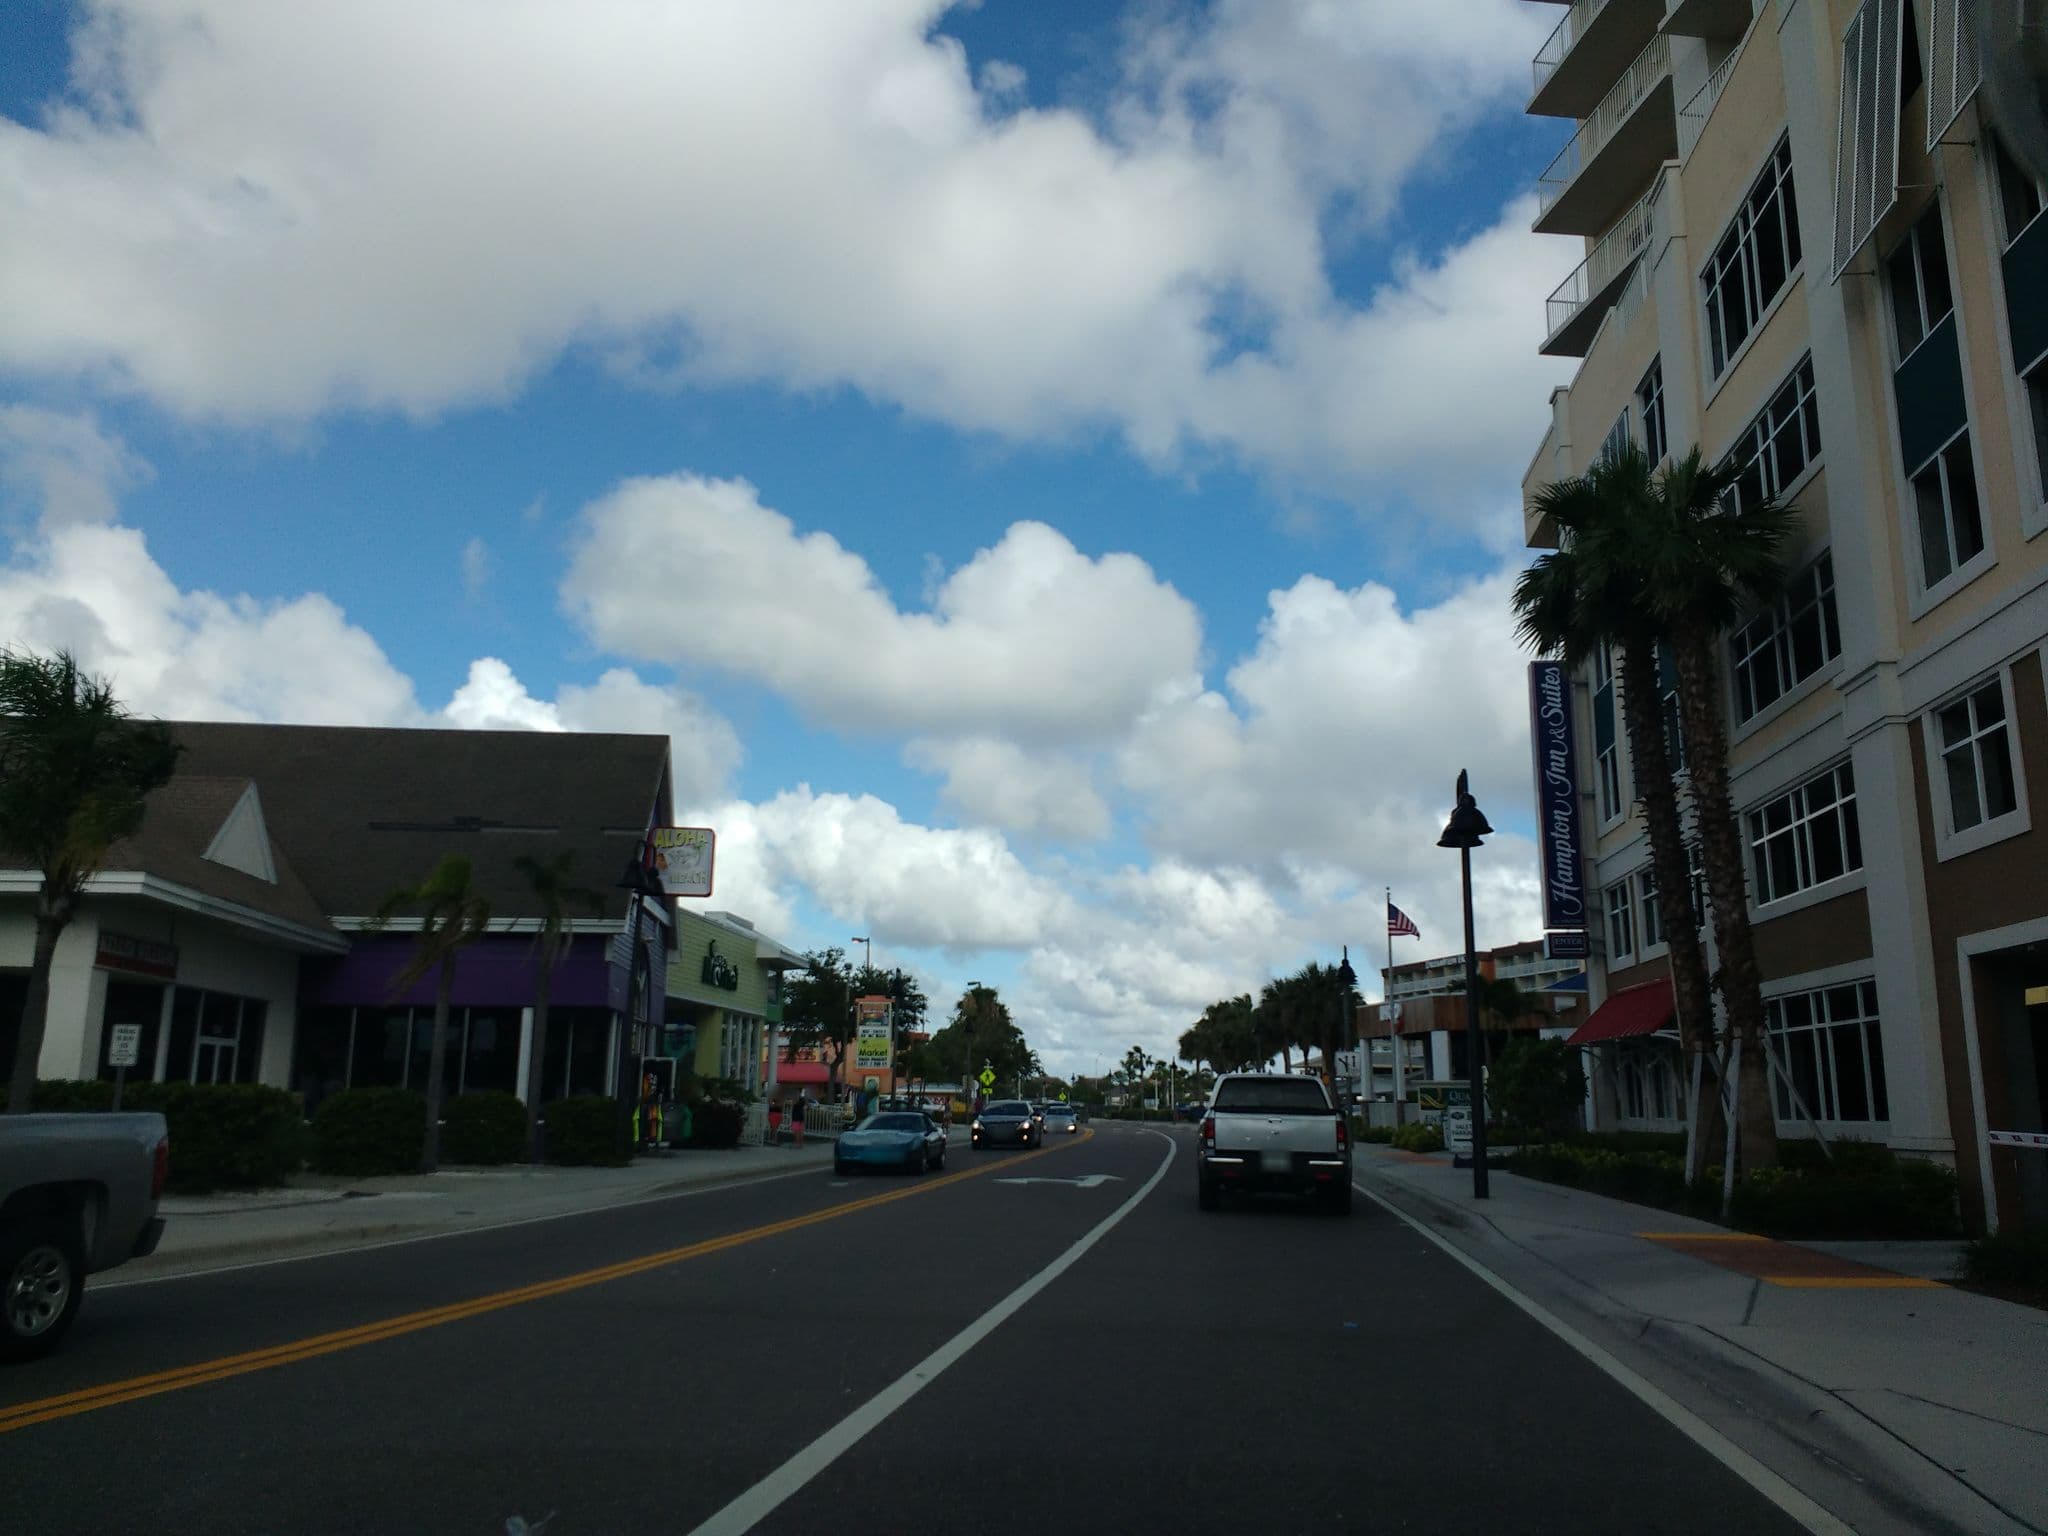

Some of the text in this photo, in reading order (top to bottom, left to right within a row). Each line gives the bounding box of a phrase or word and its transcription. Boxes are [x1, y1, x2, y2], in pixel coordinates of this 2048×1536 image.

[1540, 666, 1563, 725] Suites
[1545, 739, 1572, 796] Inn
[653, 828, 707, 848] ALOHA
[1552, 799, 1581, 916] Hampton
[858, 1047, 888, 1057] Market
